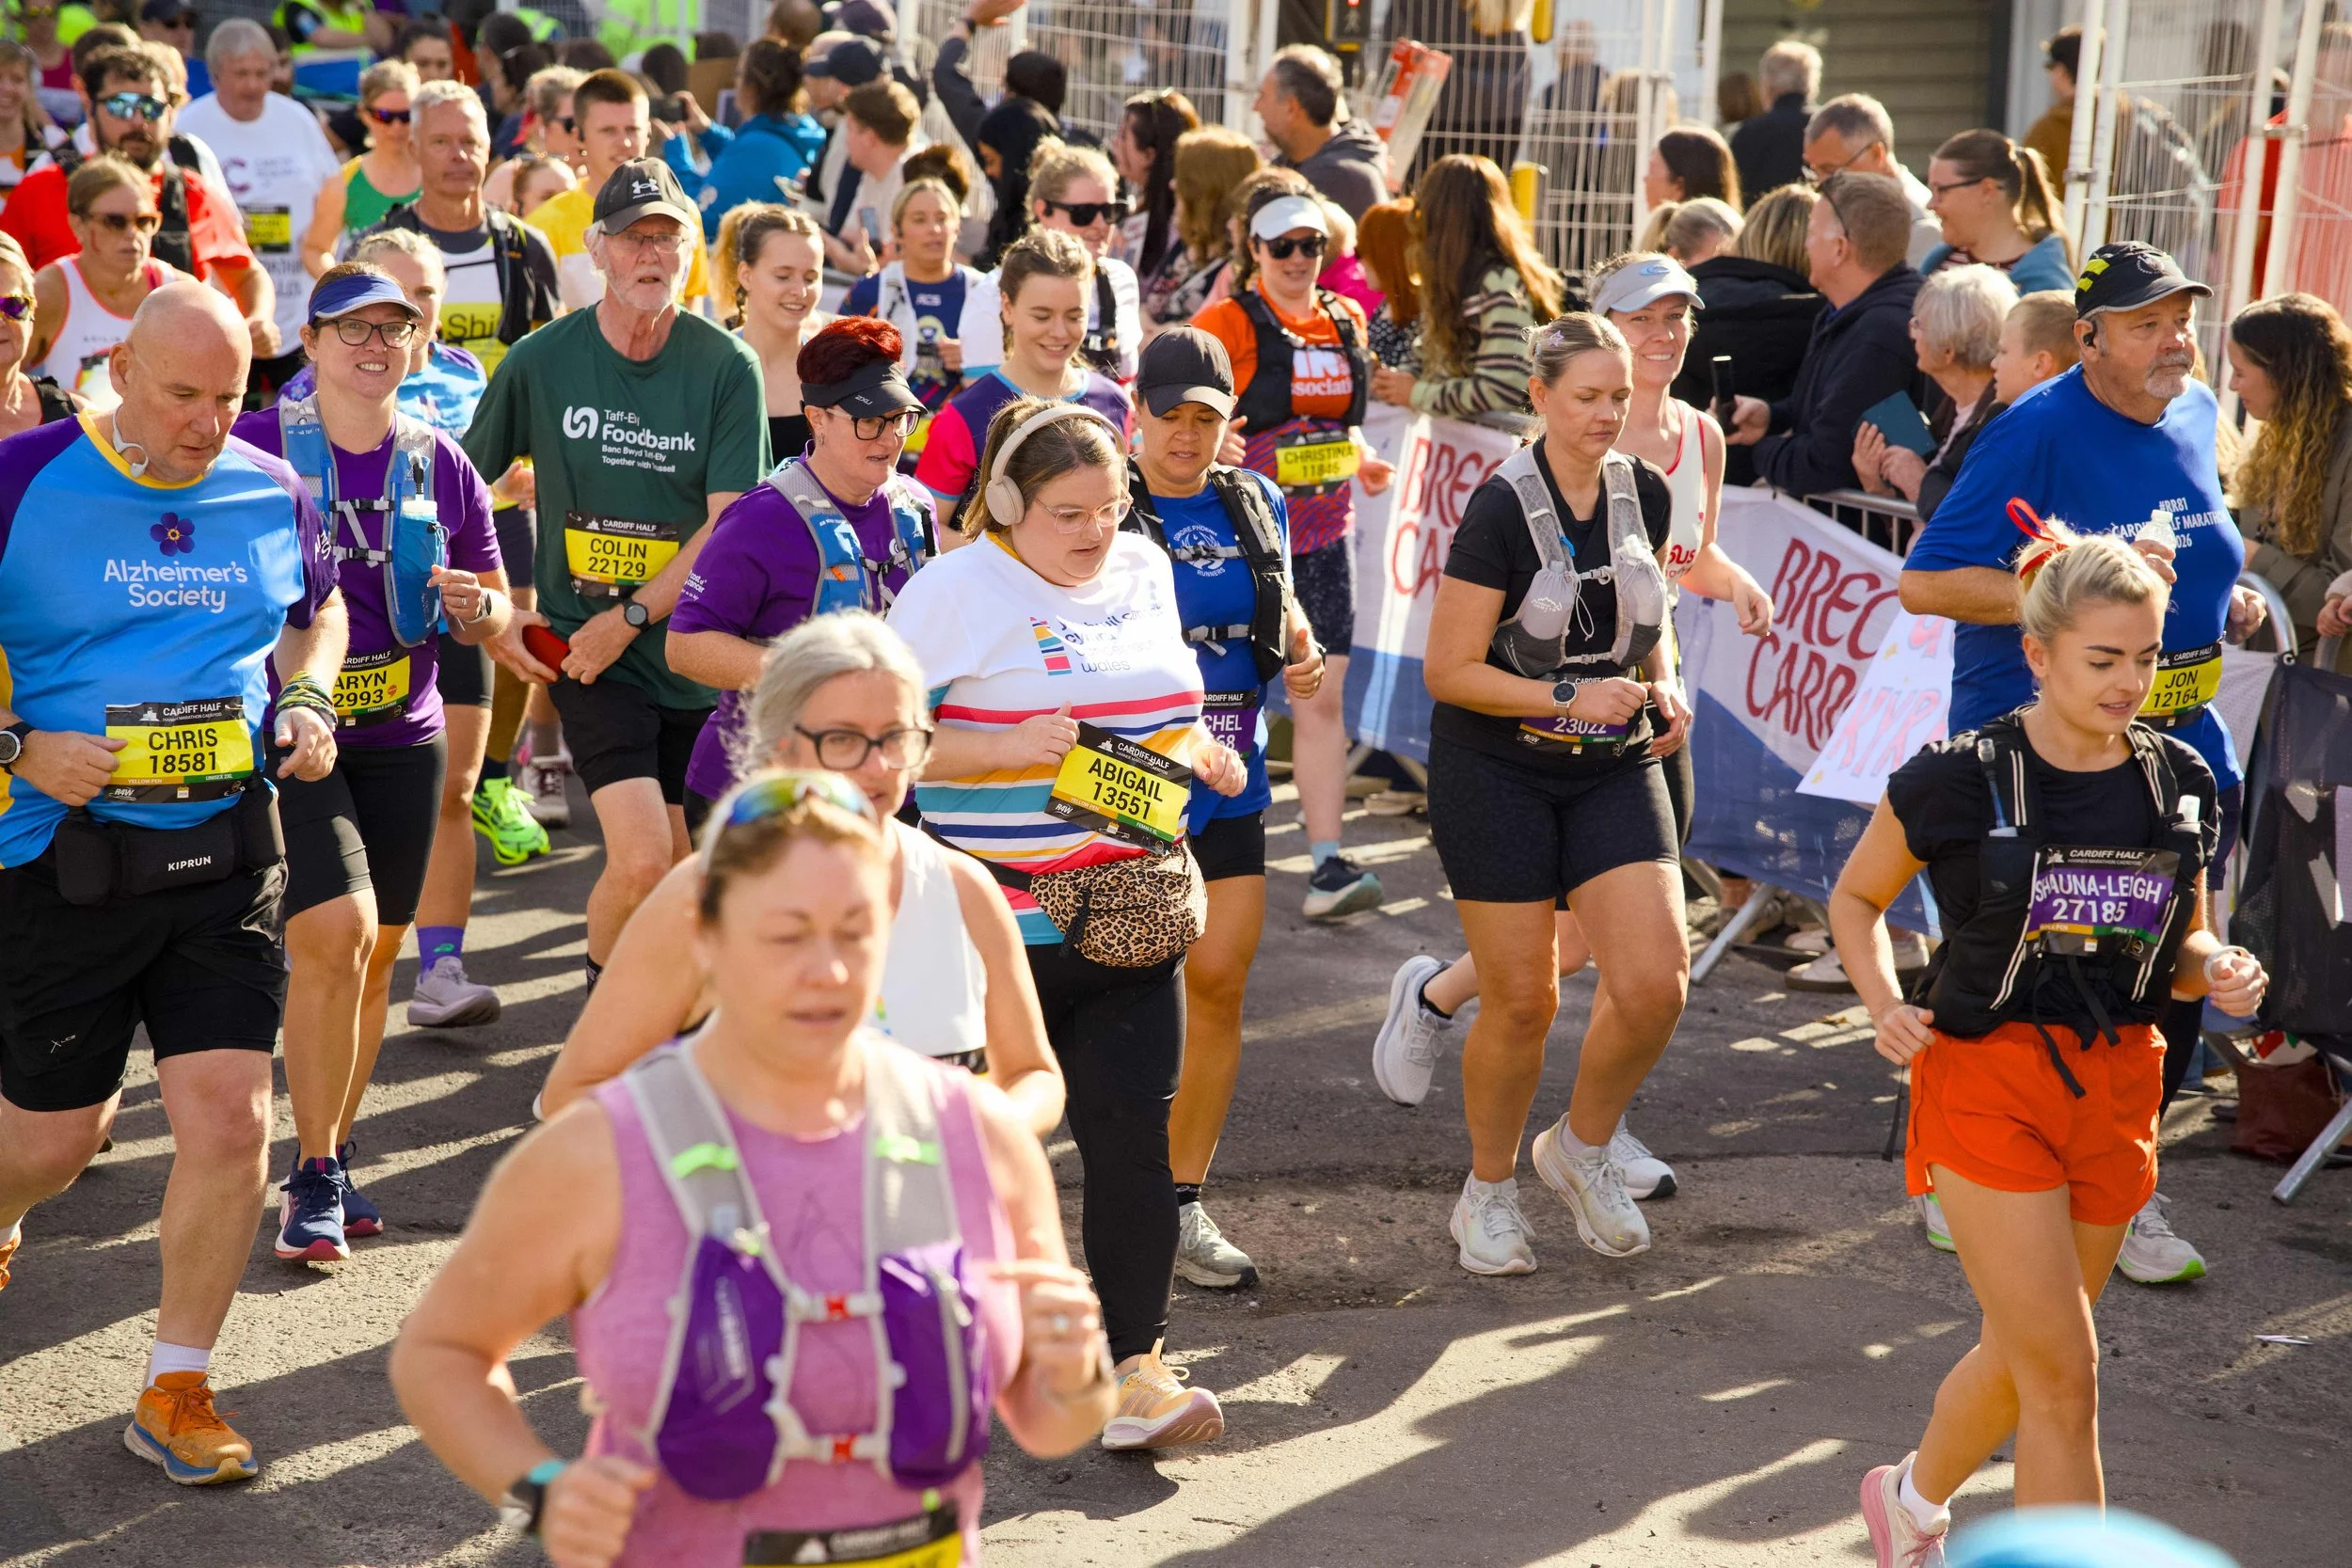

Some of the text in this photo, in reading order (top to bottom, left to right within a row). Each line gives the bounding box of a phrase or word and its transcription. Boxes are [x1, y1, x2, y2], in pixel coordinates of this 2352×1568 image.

[604, 409, 640, 426] Taff-Ely
[602, 423, 695, 451] Foodbank
[602, 444, 621, 453] Banc
[623, 447, 643, 458] Bwyd
[1283, 445, 1354, 464] CHRISTINA
[602, 455, 636, 467] Together
[2158, 497, 2188, 513] #RR81
[602, 519, 657, 532] CARDIFF HALF
[2112, 510, 2230, 537] CARDI LF MARATHON
[590, 538, 647, 559] COLIN
[2175, 532, 2193, 548] 026
[588, 557, 646, 578] 22129
[1391, 521, 1454, 600] CA
[103, 559, 248, 583] Alzheimer's
[1197, 566, 1226, 578] RUNNERS
[128, 583, 227, 614] Society
[343, 650, 391, 664] RDIFF HALF
[2173, 650, 2200, 661] CARDIFF
[2200, 645, 2213, 656] HALF
[1081, 660, 1131, 673] wales
[335, 670, 387, 689] ARYN
[2165, 670, 2198, 689] JON
[332, 689, 384, 707] 2993
[1204, 693, 1228, 702] ARDIFF
[1746, 631, 1857, 752] CARR
[2153, 687, 2199, 708] 12164
[199, 702, 222, 714] HALF
[1203, 714, 1243, 732] CHEL
[149, 728, 218, 751] CHRIS
[149, 751, 216, 774] 18581
[1118, 742, 1170, 769] CARDIFF HALF
[1088, 758, 1163, 802] ABIGAIL
[1092, 782, 1152, 820] 13551
[1071, 797, 1089, 808] YELLOW
[1136, 821, 1152, 833] FEMALE
[167, 855, 212, 872] KIPRUN
[2070, 849, 2145, 860] CARDIFF HALF
[2035, 873, 2163, 904] SHAUNA-LEIGH
[2052, 897, 2128, 924] 27185
